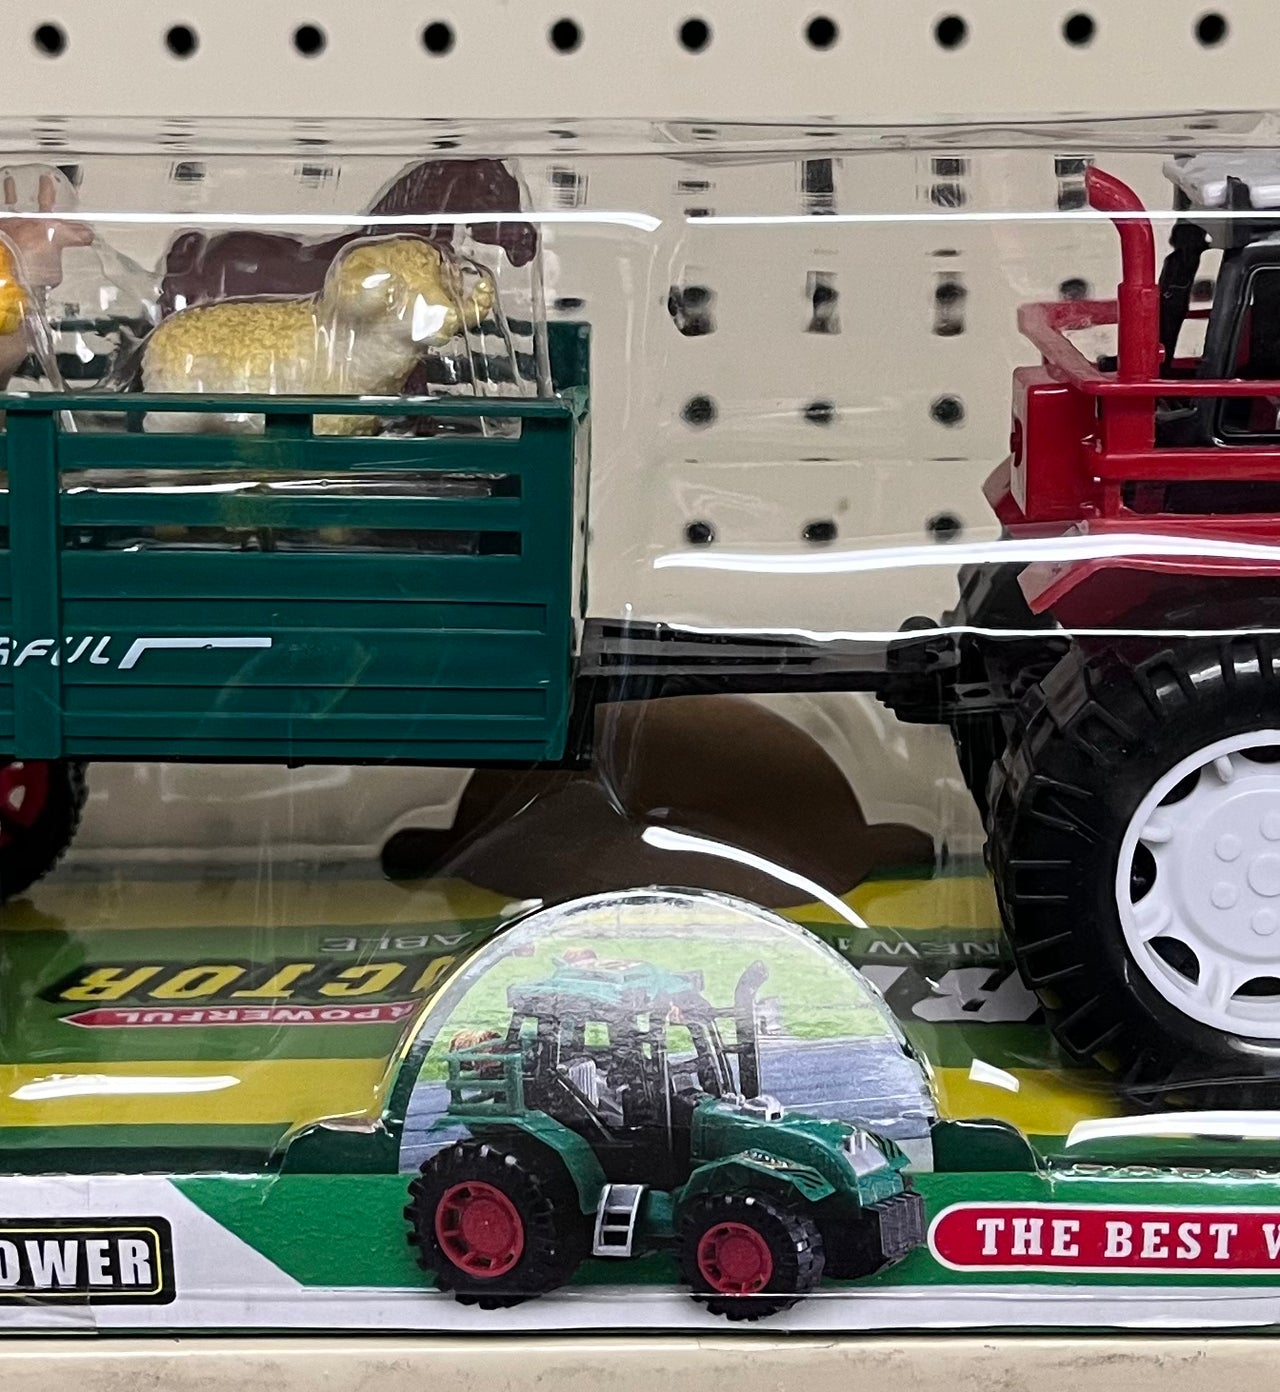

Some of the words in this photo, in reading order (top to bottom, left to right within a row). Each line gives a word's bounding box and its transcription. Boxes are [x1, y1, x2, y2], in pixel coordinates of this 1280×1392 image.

[117, 1007, 381, 1024] POWERFUL
[976, 1218, 1081, 1257] THE
[1103, 1222, 1238, 1259] BEST
